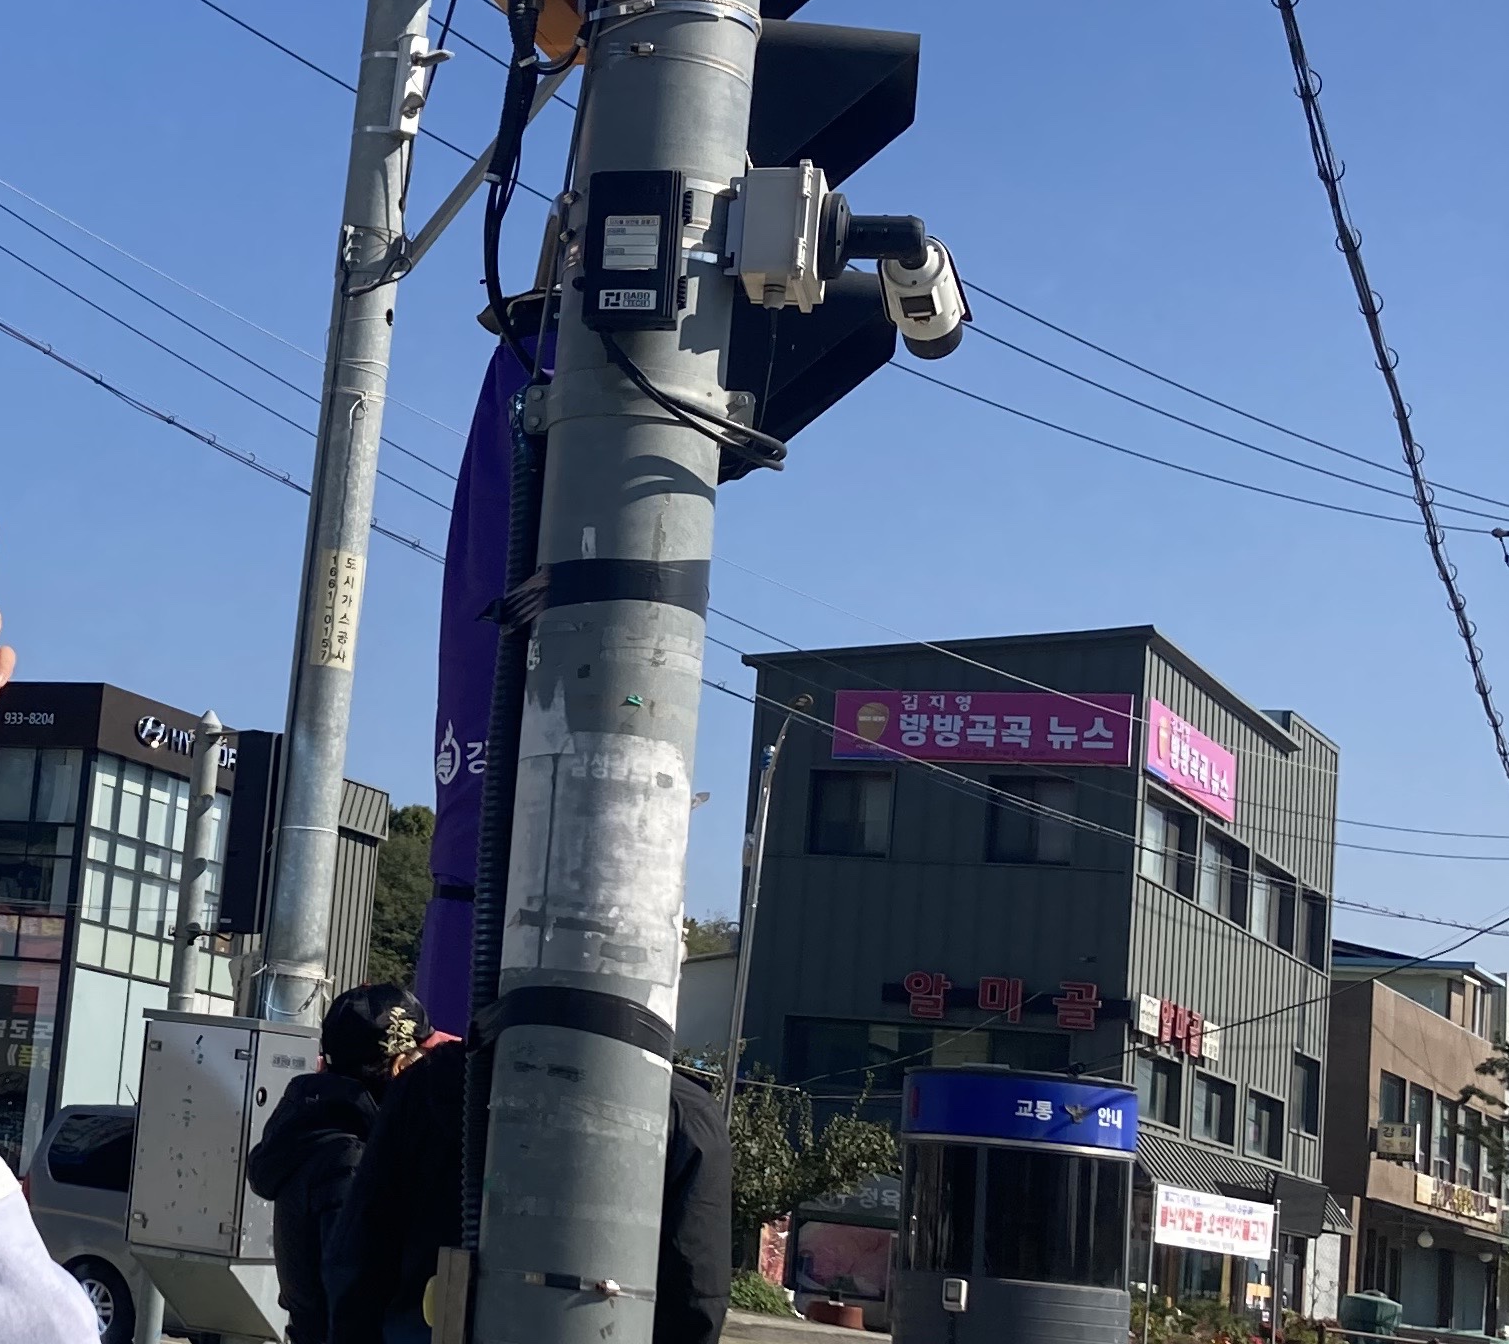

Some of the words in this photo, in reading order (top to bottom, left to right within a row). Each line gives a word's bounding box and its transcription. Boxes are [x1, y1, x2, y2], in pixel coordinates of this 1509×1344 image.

[320, 555, 338, 661] 1661-0157
[3, 711, 55, 726] 933-8204
[901, 694, 973, 713] 김지영
[899, 713, 1032, 749] 방방곡곡
[1046, 716, 1114, 750] 뉴스
[1170, 735, 1209, 790] 방방곡곡
[1210, 761, 1229, 802] 뉴스
[1014, 1099, 1054, 1122] 교통
[1097, 1106, 1123, 1130] 안내
